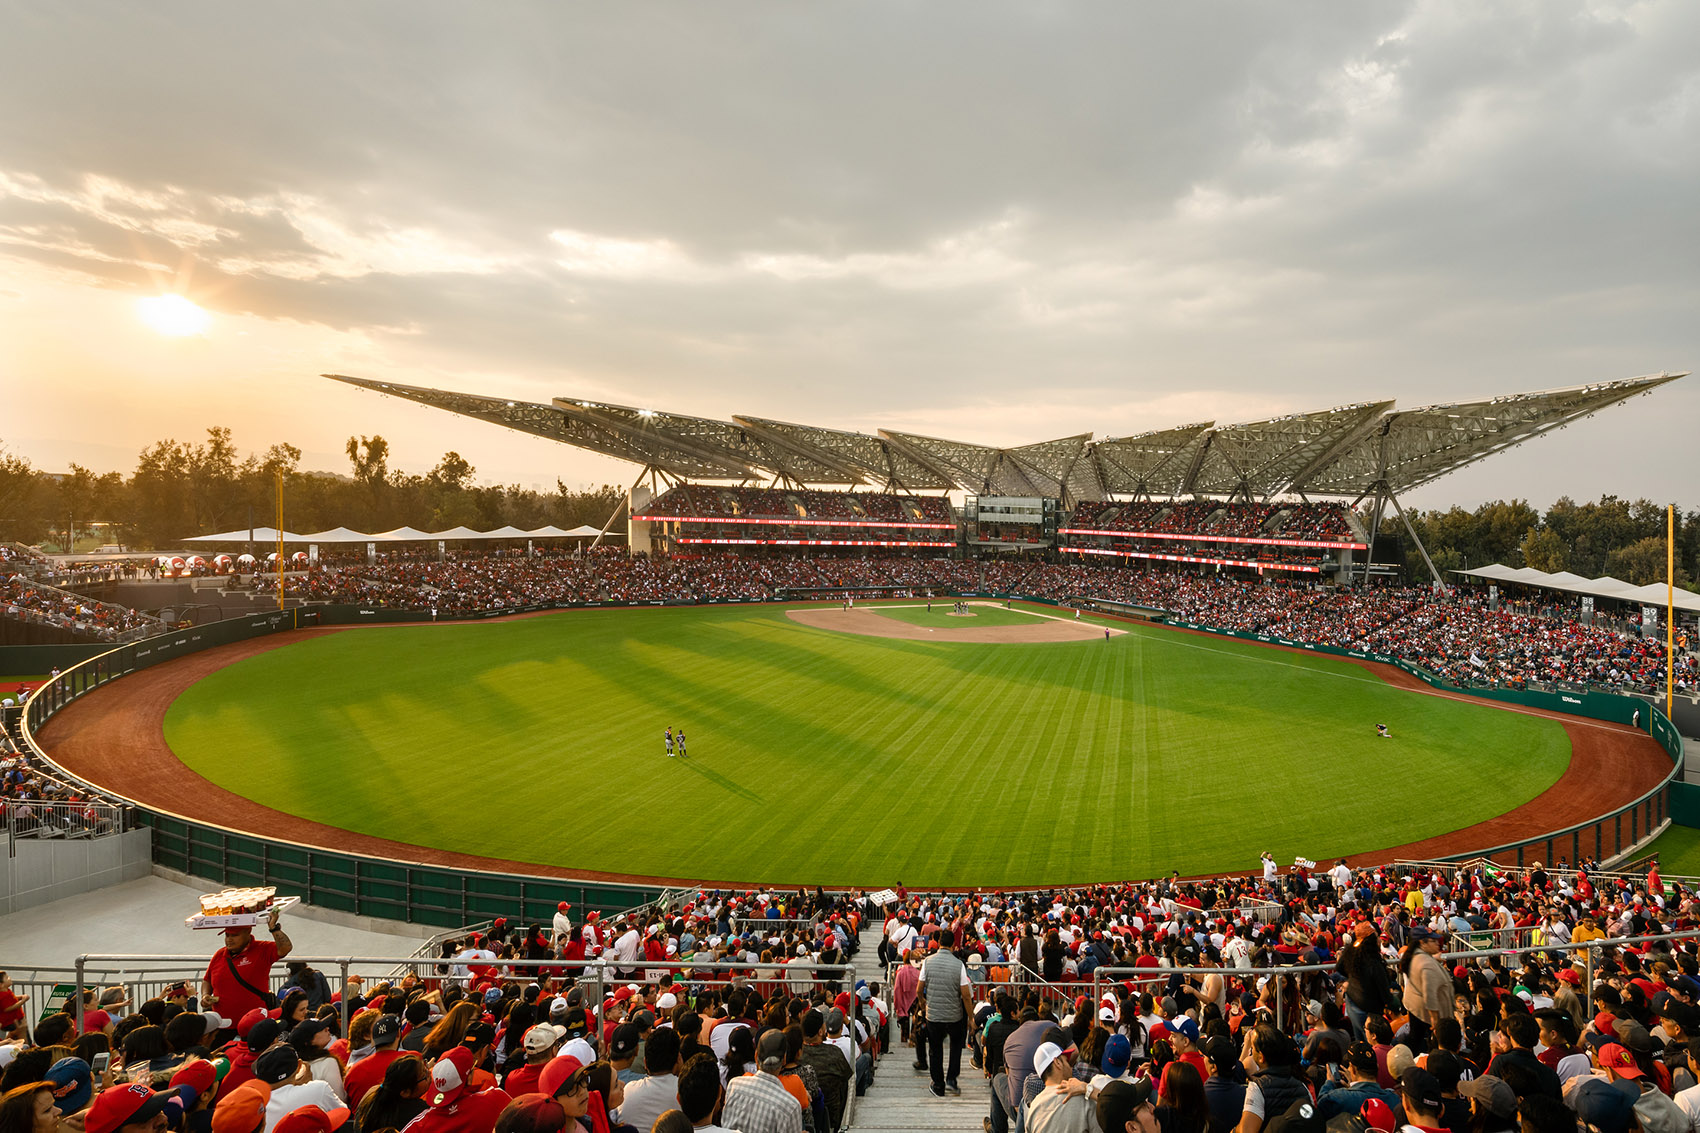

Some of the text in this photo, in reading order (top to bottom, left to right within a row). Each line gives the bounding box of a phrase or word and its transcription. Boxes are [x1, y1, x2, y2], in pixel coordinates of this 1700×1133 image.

[1644, 607, 1657, 616] B9
[1562, 695, 1582, 705] Wilson
[1236, 945, 1248, 958] 13
